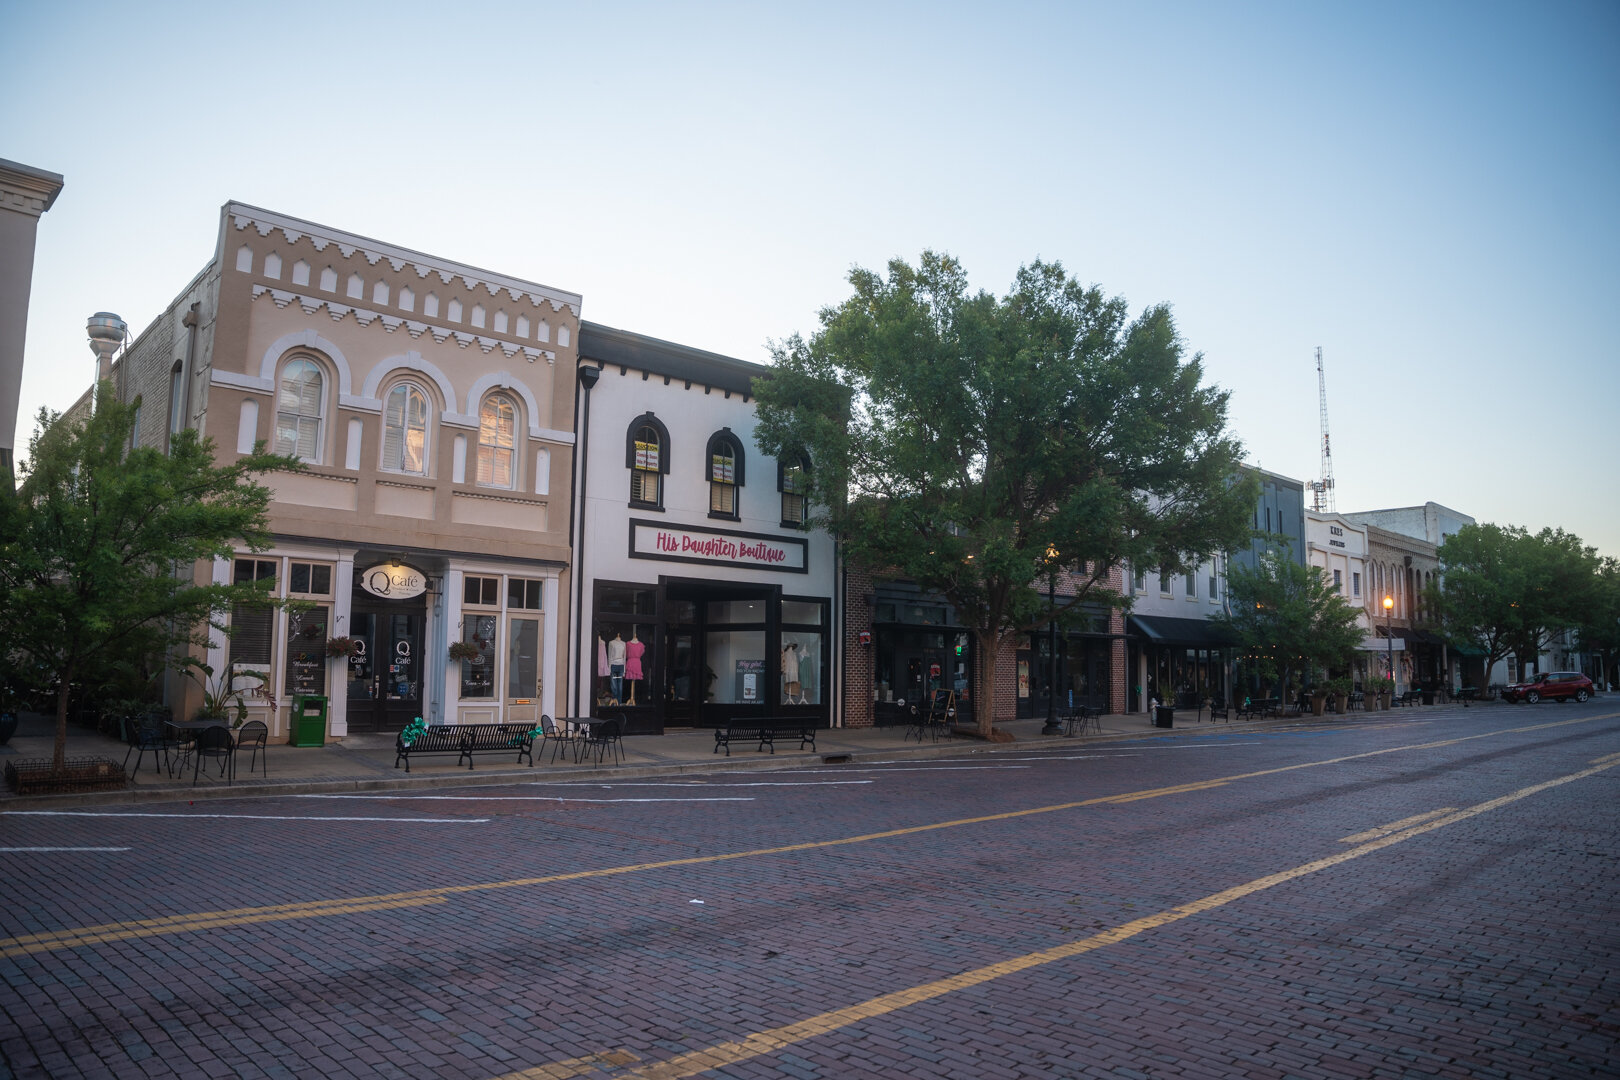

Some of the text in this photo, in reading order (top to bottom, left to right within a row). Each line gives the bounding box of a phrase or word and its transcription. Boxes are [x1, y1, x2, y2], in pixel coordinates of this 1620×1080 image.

[656, 532, 786, 562] His Daughter Boutique
[370, 571, 418, 595] Q Café
[353, 640, 366, 655] Q
[396, 641, 410, 656] Q
